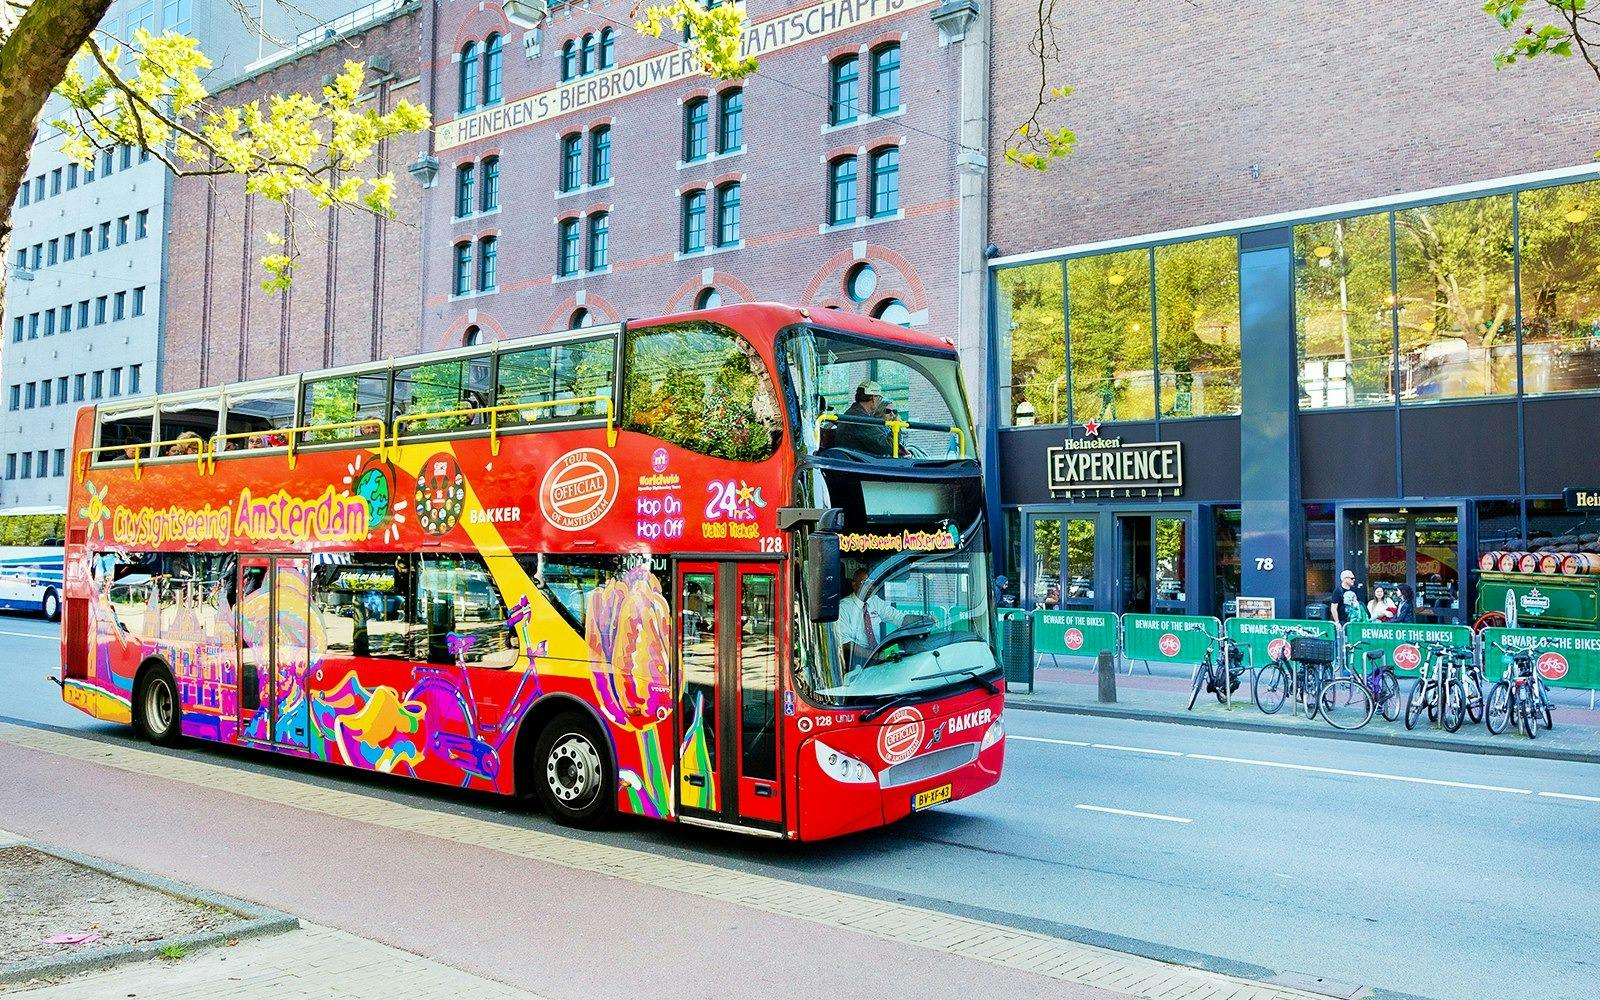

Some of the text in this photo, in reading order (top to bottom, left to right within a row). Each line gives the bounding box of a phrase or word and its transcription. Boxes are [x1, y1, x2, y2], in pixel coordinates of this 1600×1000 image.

[457, 94, 549, 143] HEINEKEN'S
[1065, 437, 1120, 450] Heineken
[563, 453, 588, 467] TOUR
[1054, 449, 1174, 482] EXPERIENCE
[554, 477, 604, 501] OFFICIAL
[1050, 488, 1180, 499] AMSTERDAM
[637, 495, 682, 517] Hop On
[704, 480, 737, 520] 24
[235, 489, 368, 540] Amsterdam
[469, 506, 521, 524] BAKKER
[551, 498, 609, 527] OF AMSTERDAM
[637, 518, 684, 540] Hop Off
[759, 536, 783, 553] 128
[903, 529, 955, 551] Amsterdam
[1254, 557, 1274, 571] 78
[1043, 614, 1105, 627] BEWARE OF THE BIKES!
[1135, 619, 1160, 630] BEWARE
[1160, 620, 1170, 631] OF
[1171, 621, 1183, 631] THE
[1240, 623, 1268, 635] BEWARE
[1361, 628, 1453, 642] BEWARE OF THE BIKES!
[1501, 634, 1537, 648] BEWARE
[815, 716, 833, 727] 128
[948, 708, 992, 734] BAKKER
[919, 787, 950, 806] BV-XF-43
